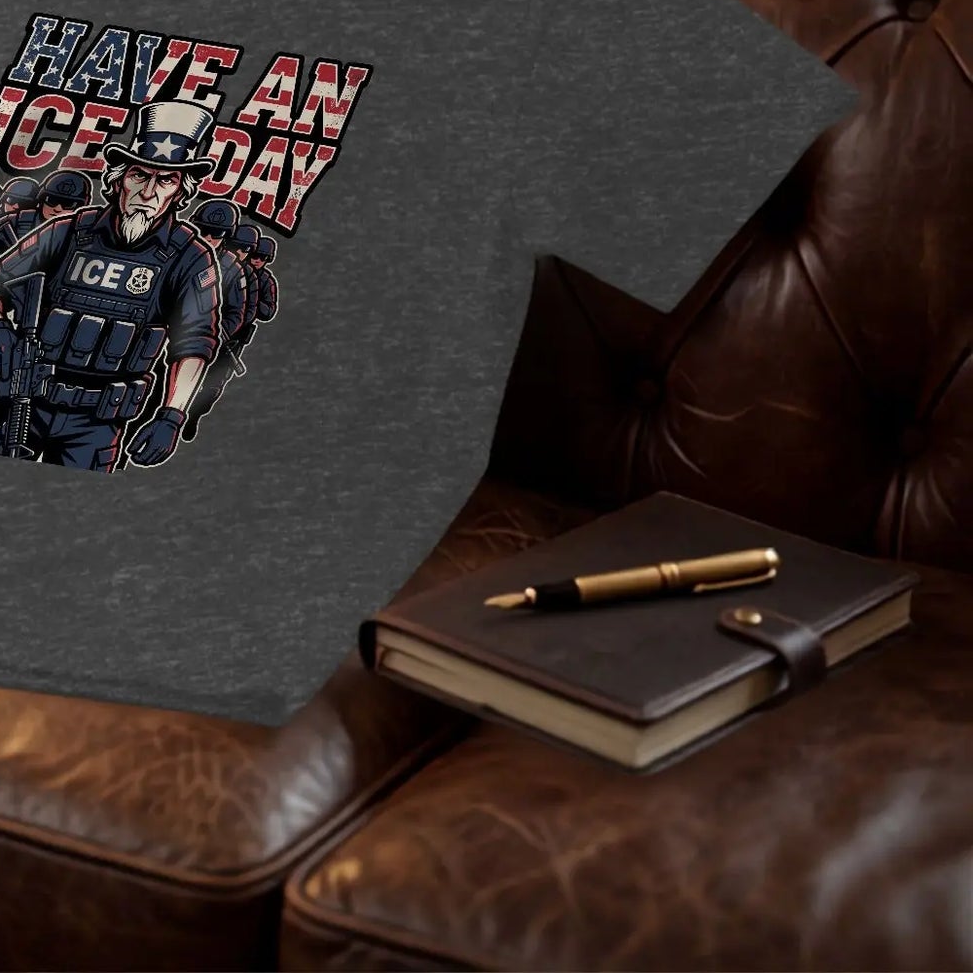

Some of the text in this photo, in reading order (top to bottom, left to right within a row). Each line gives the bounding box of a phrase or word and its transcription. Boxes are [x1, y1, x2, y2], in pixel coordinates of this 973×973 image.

[7, 16, 369, 140] HAVE AN
[198, 125, 337, 231] DAY
[70, 256, 125, 289] ICE
